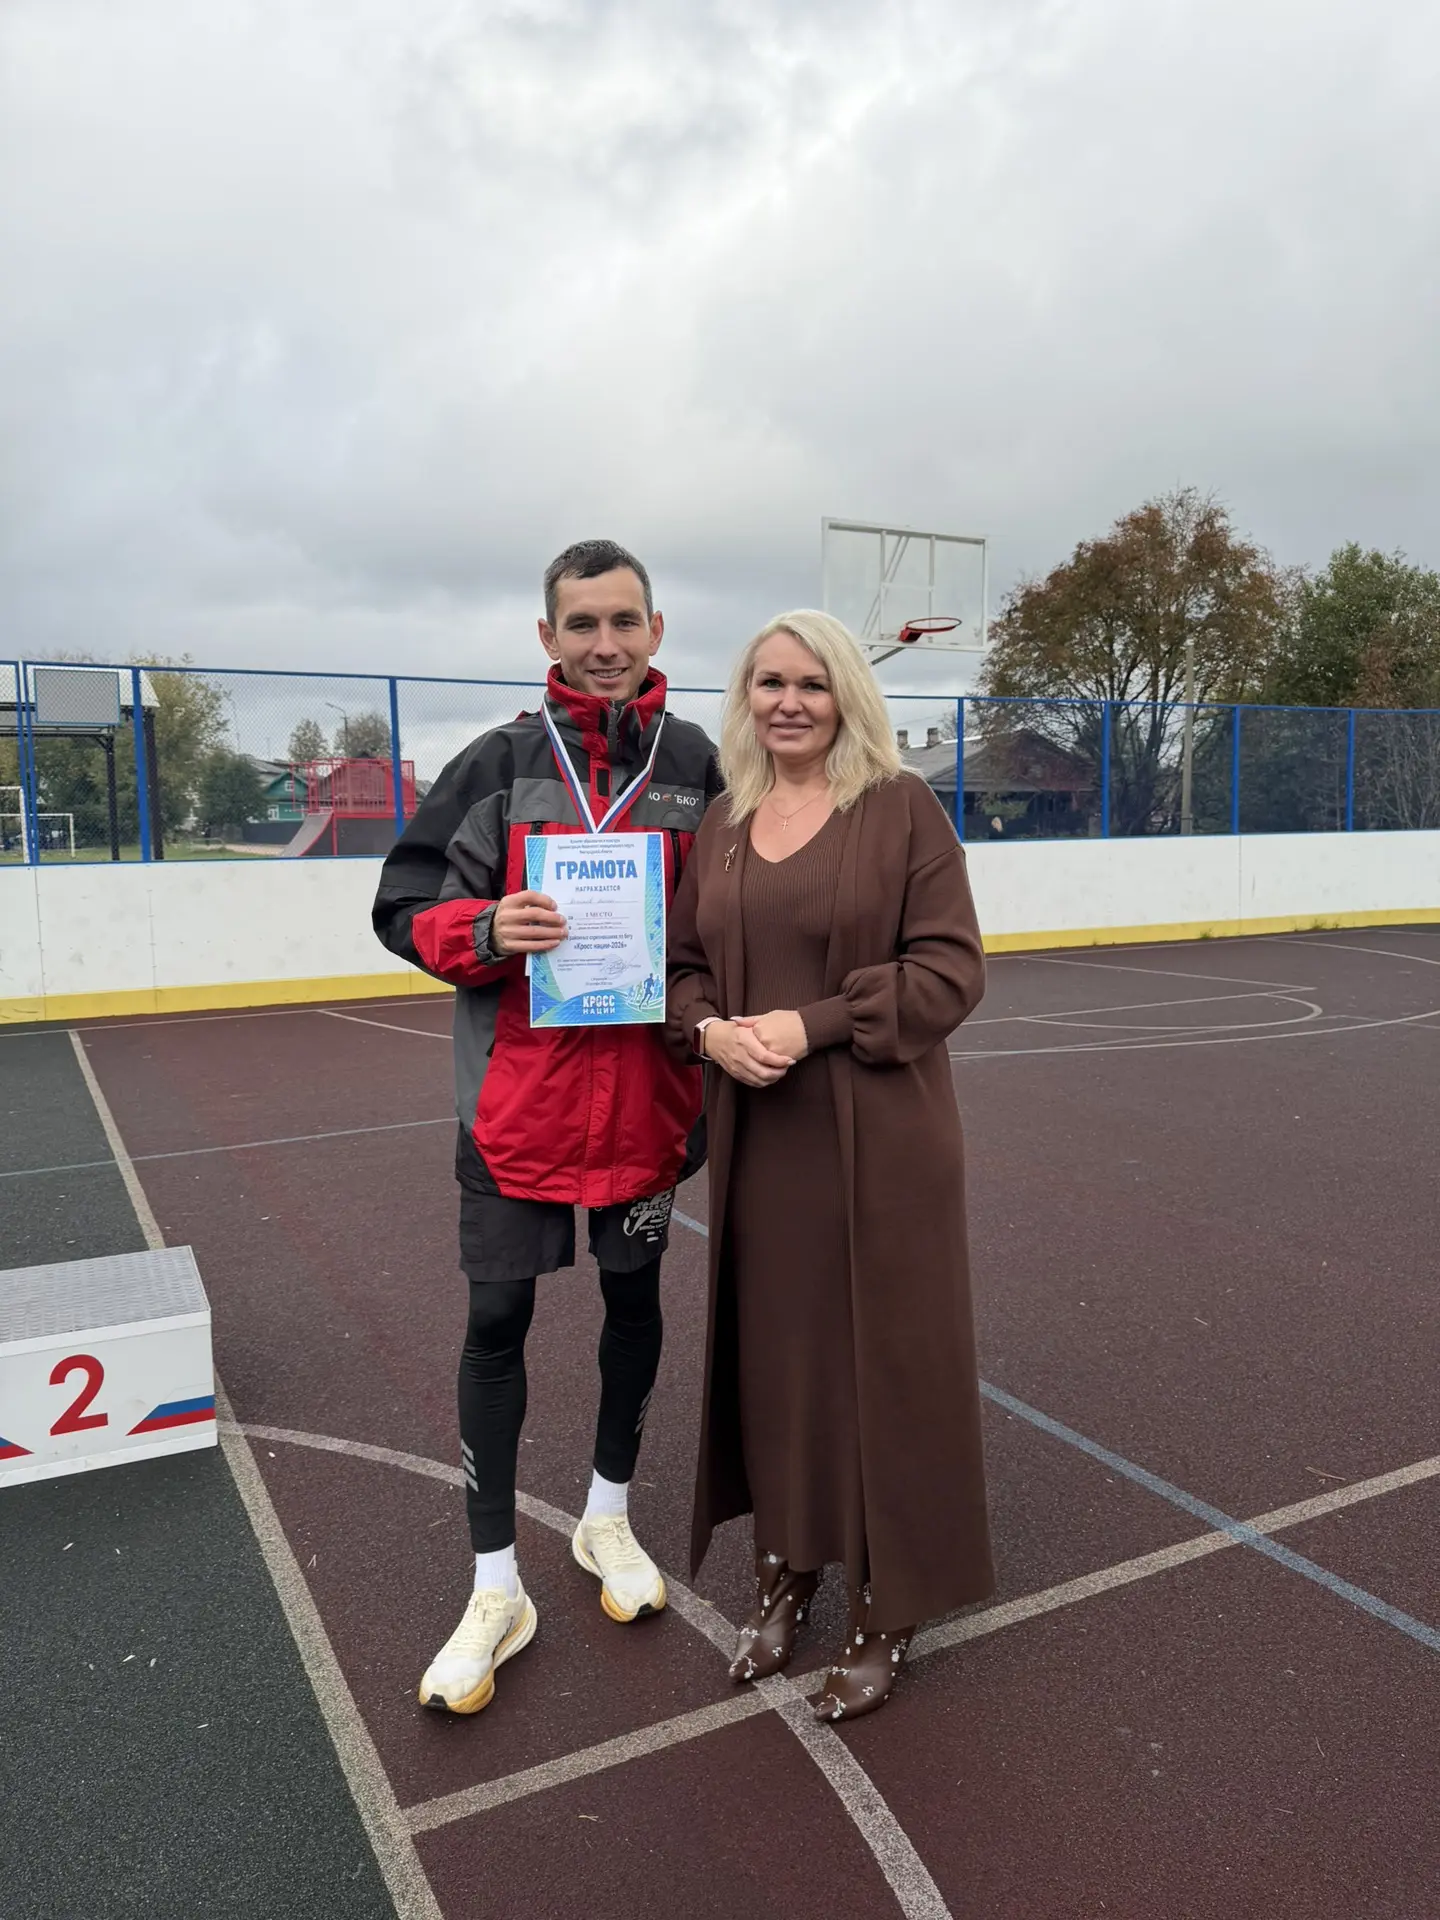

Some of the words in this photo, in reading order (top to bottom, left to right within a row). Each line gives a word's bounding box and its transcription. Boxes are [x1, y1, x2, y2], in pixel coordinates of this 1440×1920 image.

[555, 859, 638, 880] ГРАМОТА
[582, 995, 616, 1008] КРОСС
[582, 1007, 616, 1015] НАЦИИ
[49, 1354, 109, 1436] 2
